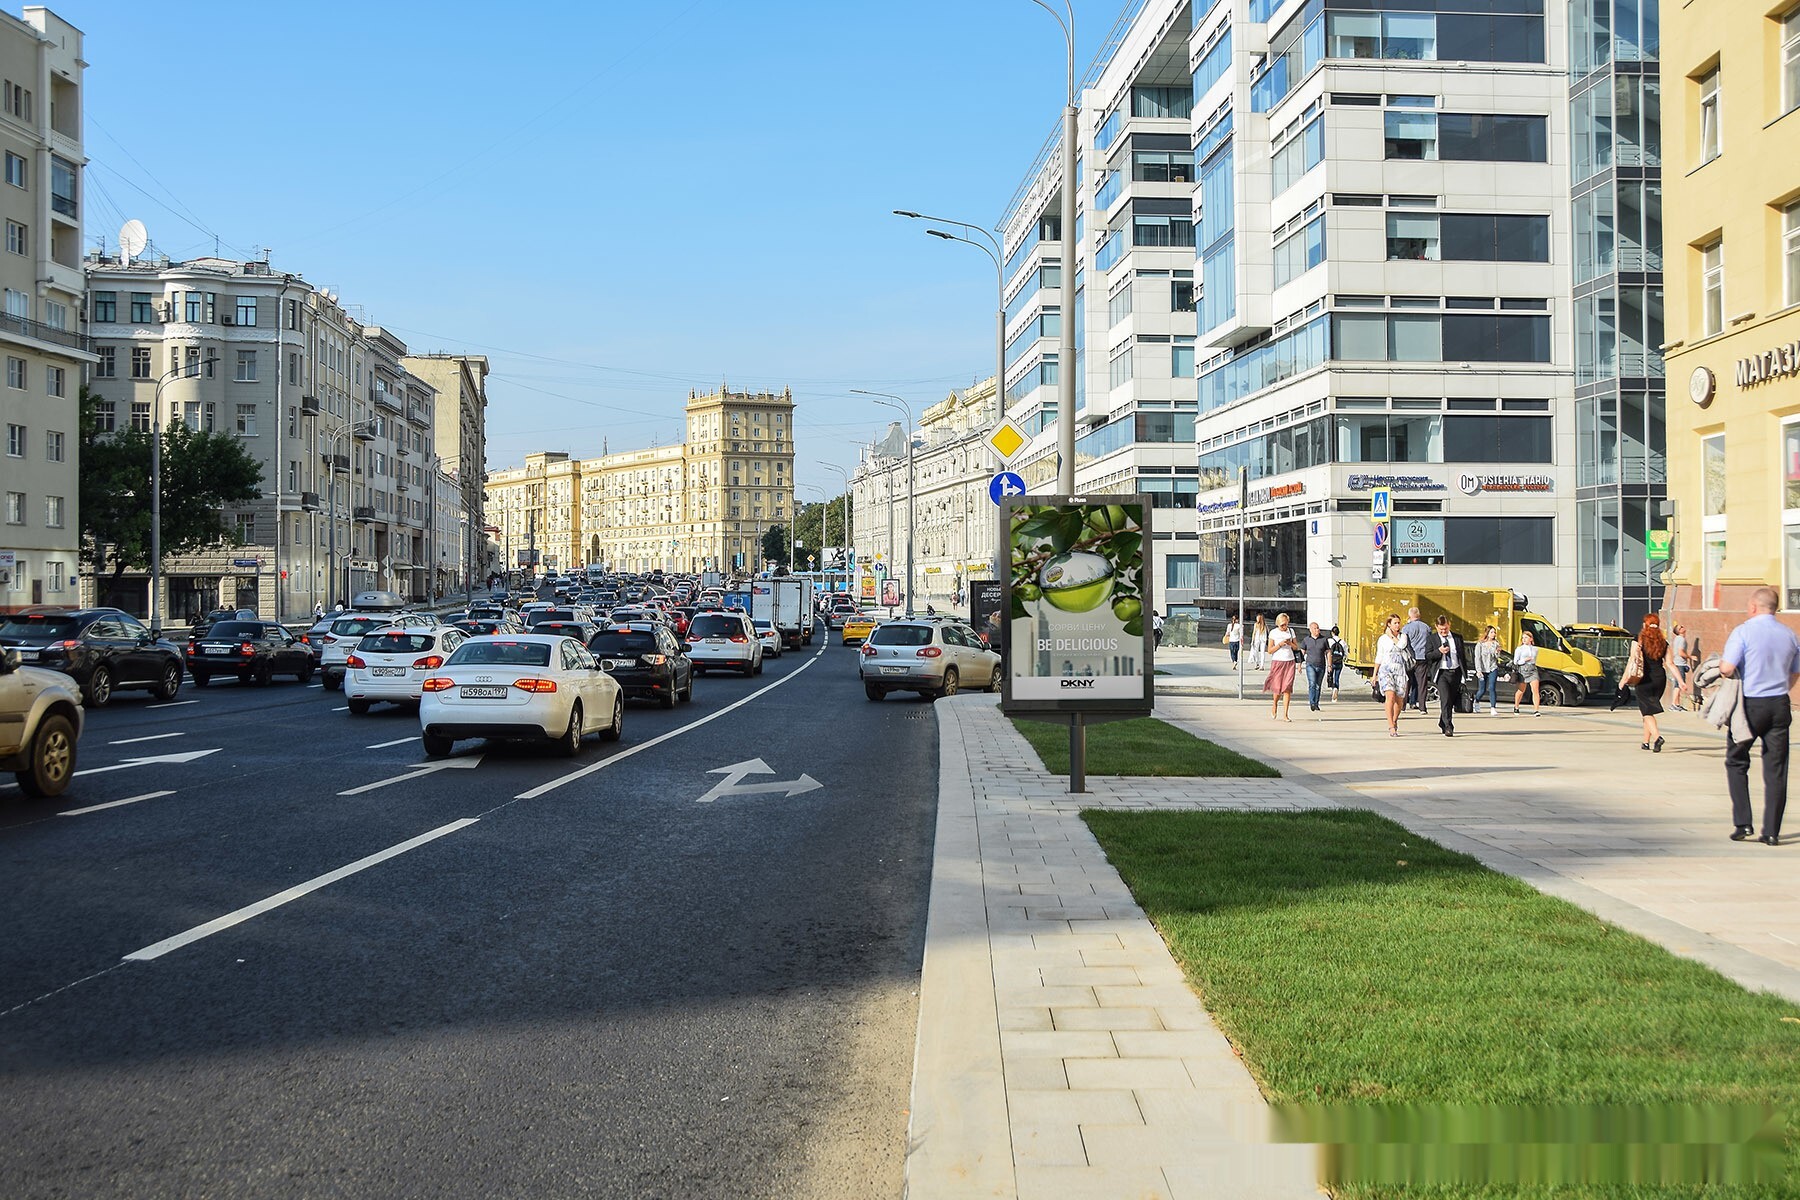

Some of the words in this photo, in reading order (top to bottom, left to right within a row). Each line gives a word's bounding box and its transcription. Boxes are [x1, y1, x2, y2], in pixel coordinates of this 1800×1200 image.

[1481, 474, 1518, 485] OSTERIA
[1523, 474, 1550, 485] MARIO
[1410, 525, 1423, 534] 24
[1048, 623, 1080, 631] СОРВИ
[1082, 623, 1106, 632] ЦЕНУ
[1037, 639, 1053, 651] BE
[1056, 638, 1118, 651] DELICIOUS
[1060, 679, 1095, 687] DKNY
